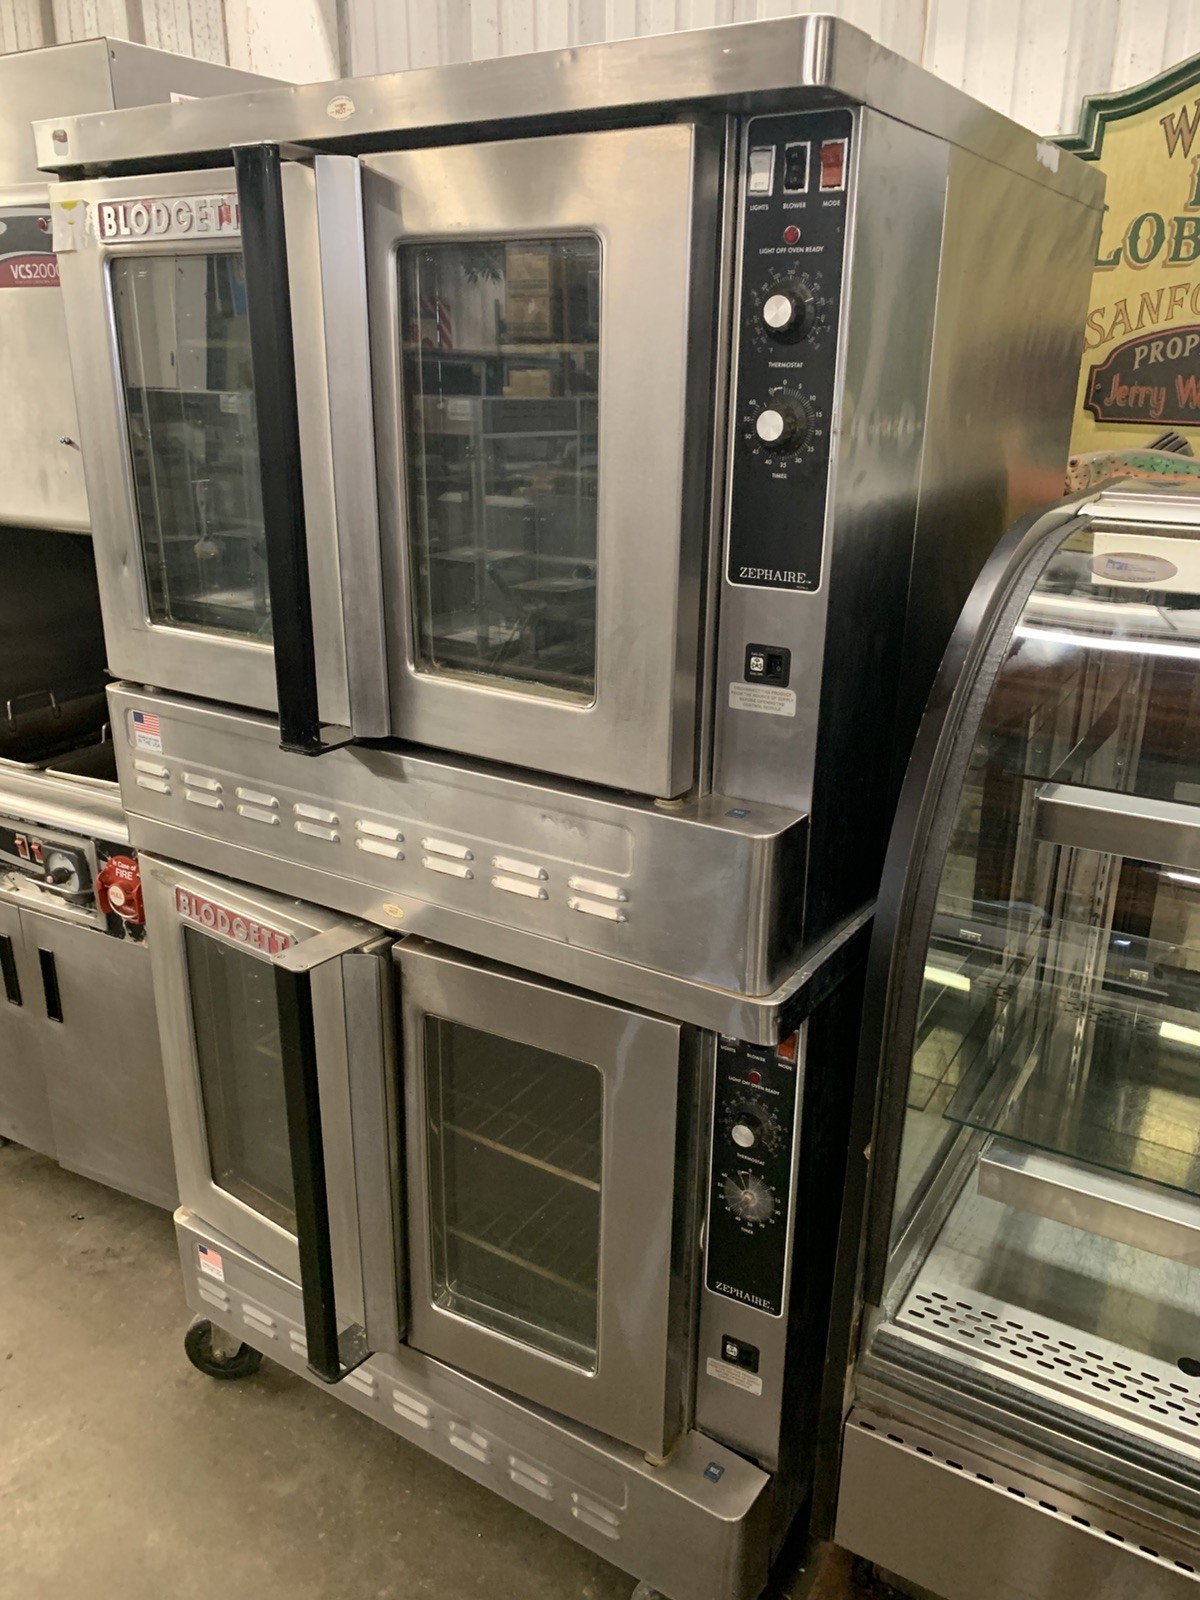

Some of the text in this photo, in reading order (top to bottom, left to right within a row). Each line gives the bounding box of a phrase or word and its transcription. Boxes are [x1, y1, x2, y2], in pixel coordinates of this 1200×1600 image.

[1104, 373, 1166, 419] Jerry
[739, 567, 806, 584] ZEPHAIRE
[115, 867, 133, 881] FIRE
[180, 893, 286, 954] BLODGETT
[715, 1281, 771, 1309] ZEPHAIRE
